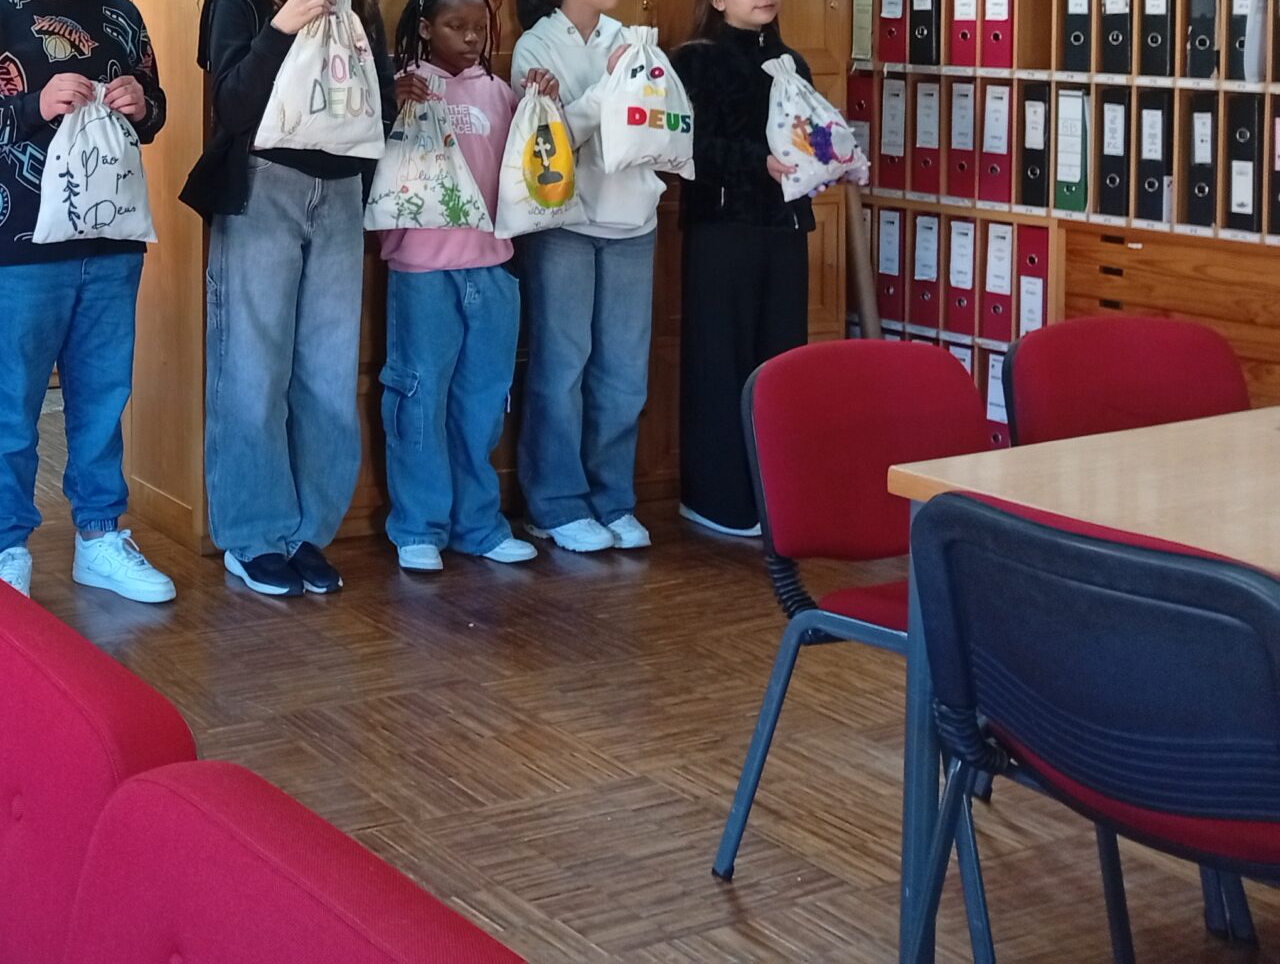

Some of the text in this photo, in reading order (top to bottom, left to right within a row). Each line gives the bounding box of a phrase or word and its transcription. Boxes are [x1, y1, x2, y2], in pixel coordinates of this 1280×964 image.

[34, 17, 90, 55] KNICKS
[310, 78, 376, 118] DEUS
[448, 105, 469, 115] THE
[449, 115, 471, 126] RTH
[452, 125, 472, 134] ACE
[627, 106, 691, 134] DEUS
[81, 146, 119, 192] Pão
[83, 199, 136, 230] Deus
